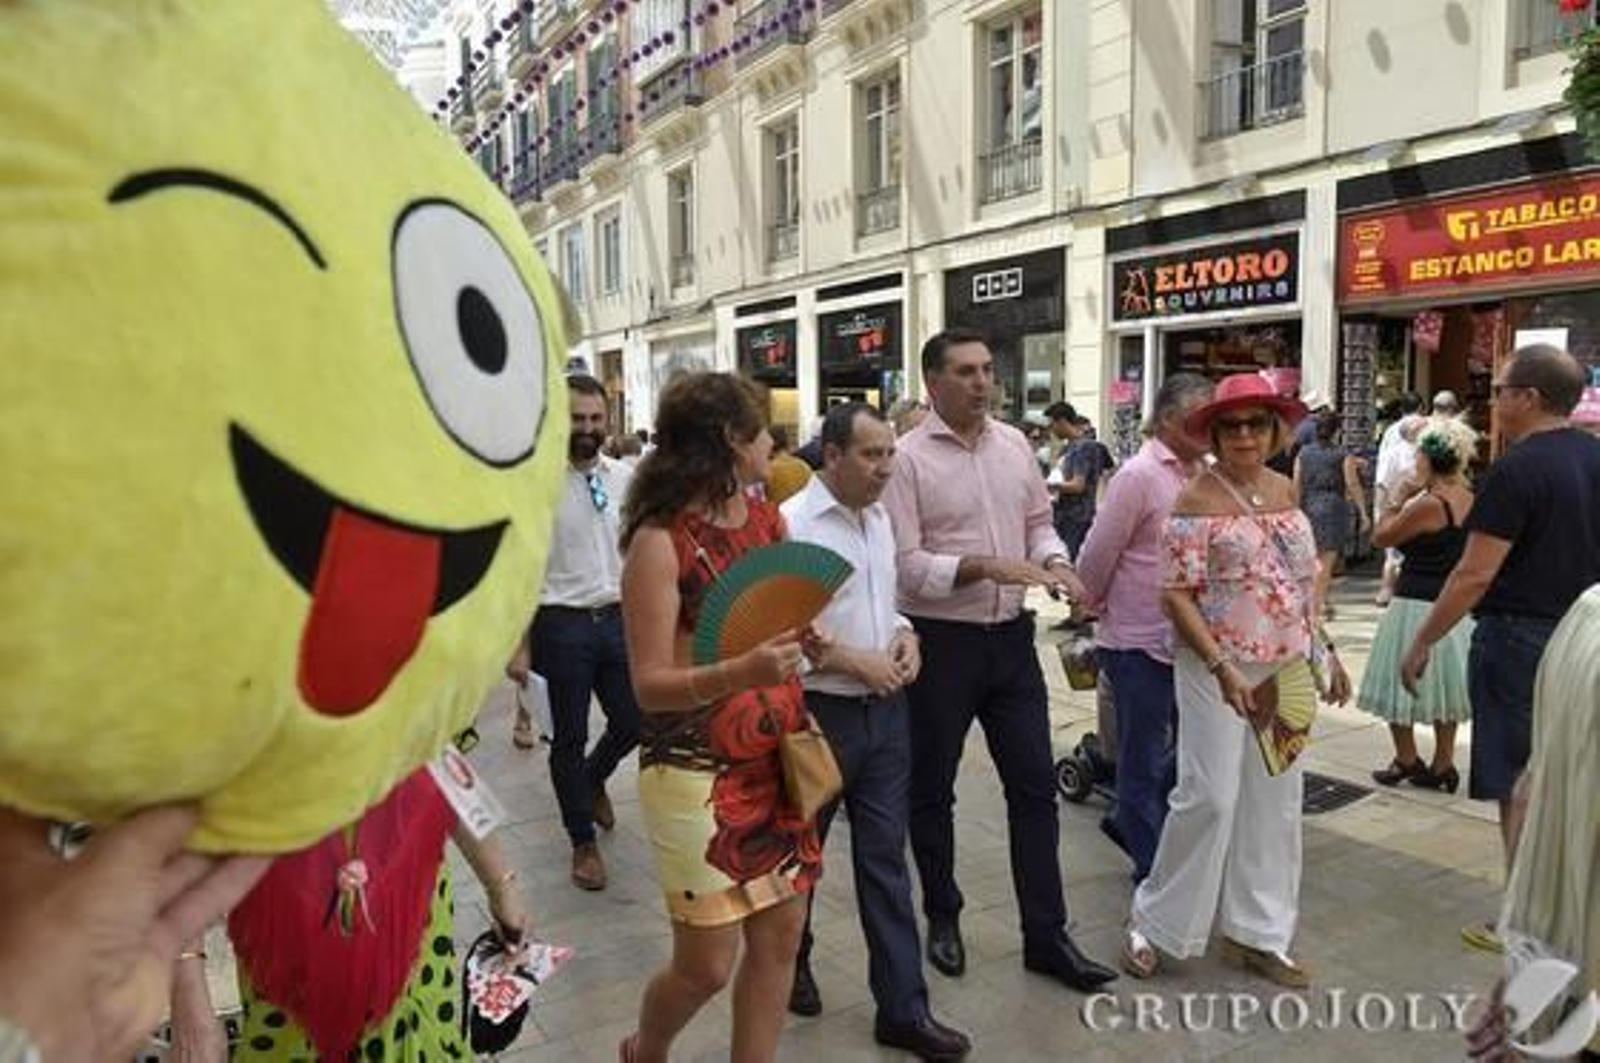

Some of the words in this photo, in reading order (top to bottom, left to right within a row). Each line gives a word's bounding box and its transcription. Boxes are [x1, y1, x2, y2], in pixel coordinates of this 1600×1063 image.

[1487, 195, 1598, 227] TABACO
[1410, 246, 1535, 281] ESTANCO
[1154, 281, 1289, 310] SOUVENIRS
